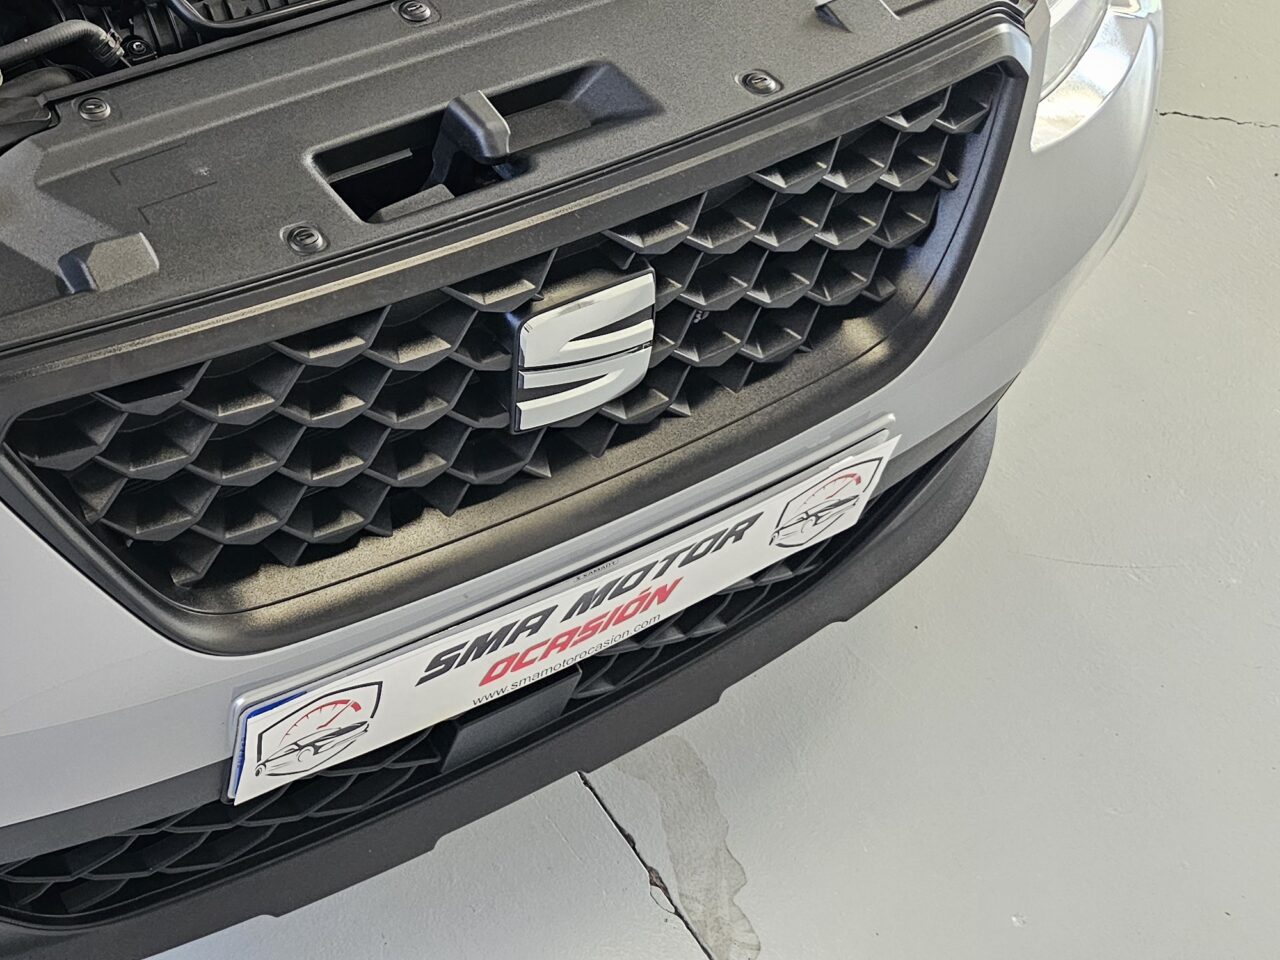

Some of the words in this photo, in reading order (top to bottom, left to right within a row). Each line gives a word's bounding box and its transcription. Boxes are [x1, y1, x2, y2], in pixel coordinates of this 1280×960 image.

[415, 604, 560, 687] SMA
[560, 511, 764, 623] MOTOR
[478, 576, 685, 687] OCASIÓN
[472, 613, 662, 707] www.smamotorocasion.com
